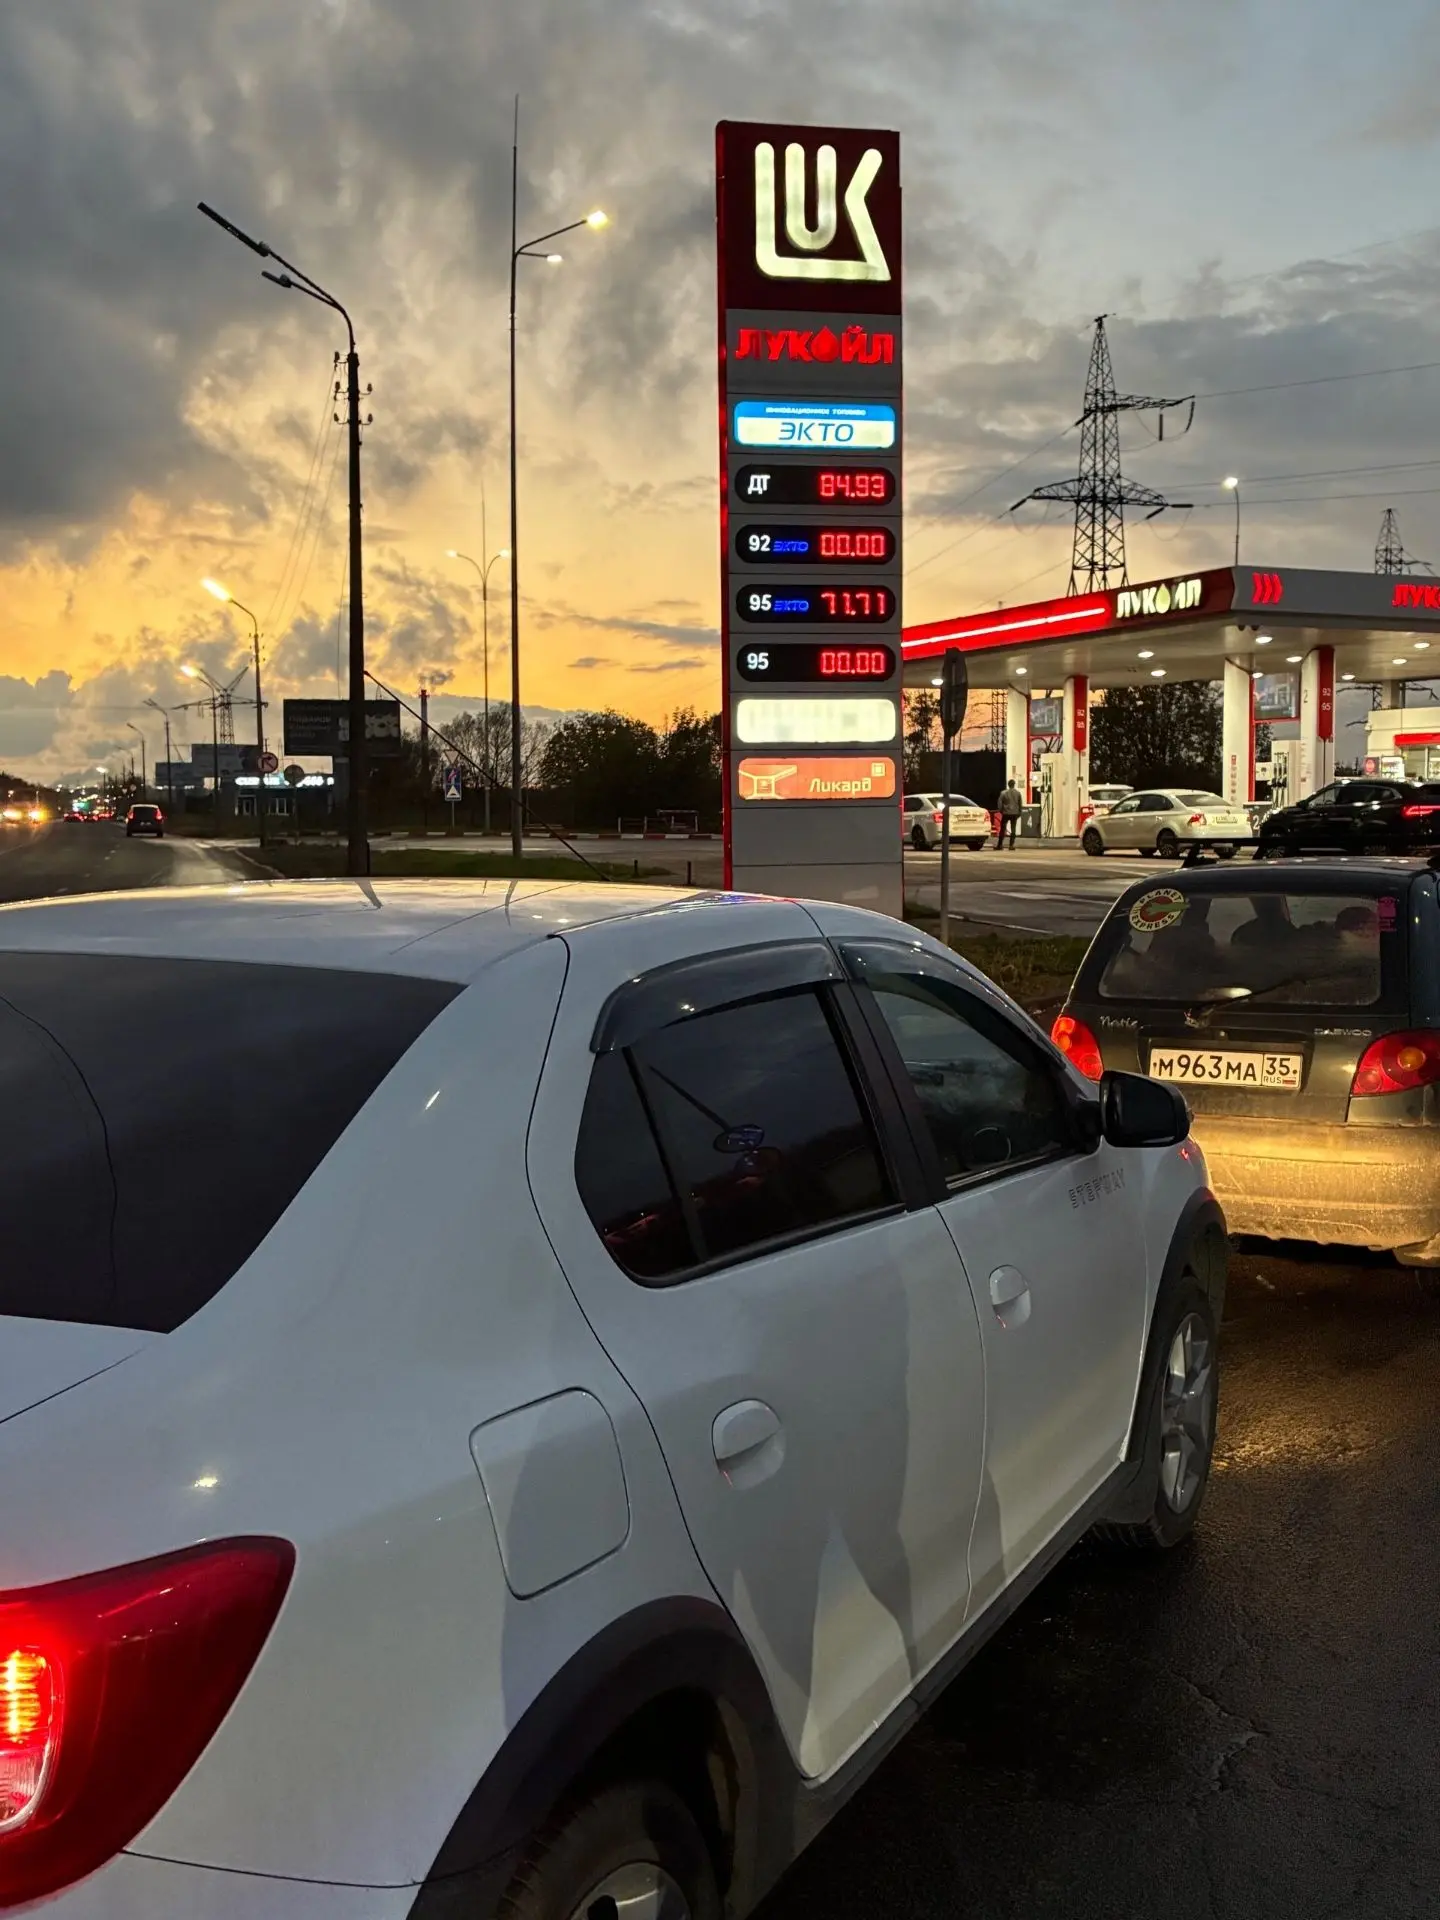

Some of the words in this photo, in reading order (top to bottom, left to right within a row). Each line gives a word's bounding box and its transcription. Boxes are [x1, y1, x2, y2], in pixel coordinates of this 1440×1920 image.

[778, 422, 854, 442] ЭКТО
[748, 474, 771, 495] ДТ
[820, 475, 885, 498] 84.93
[749, 535, 770, 552] 92
[820, 534, 885, 557] 00.00
[749, 594, 772, 612] 95
[821, 593, 885, 615] 71.71
[1391, 583, 1440, 609] ЛУК
[747, 652, 769, 670] 95
[821, 651, 885, 674] 00.00
[808, 777, 872, 798] Ликард
[1265, 1057, 1291, 1076] 35
[1263, 1075, 1282, 1084] RUS
